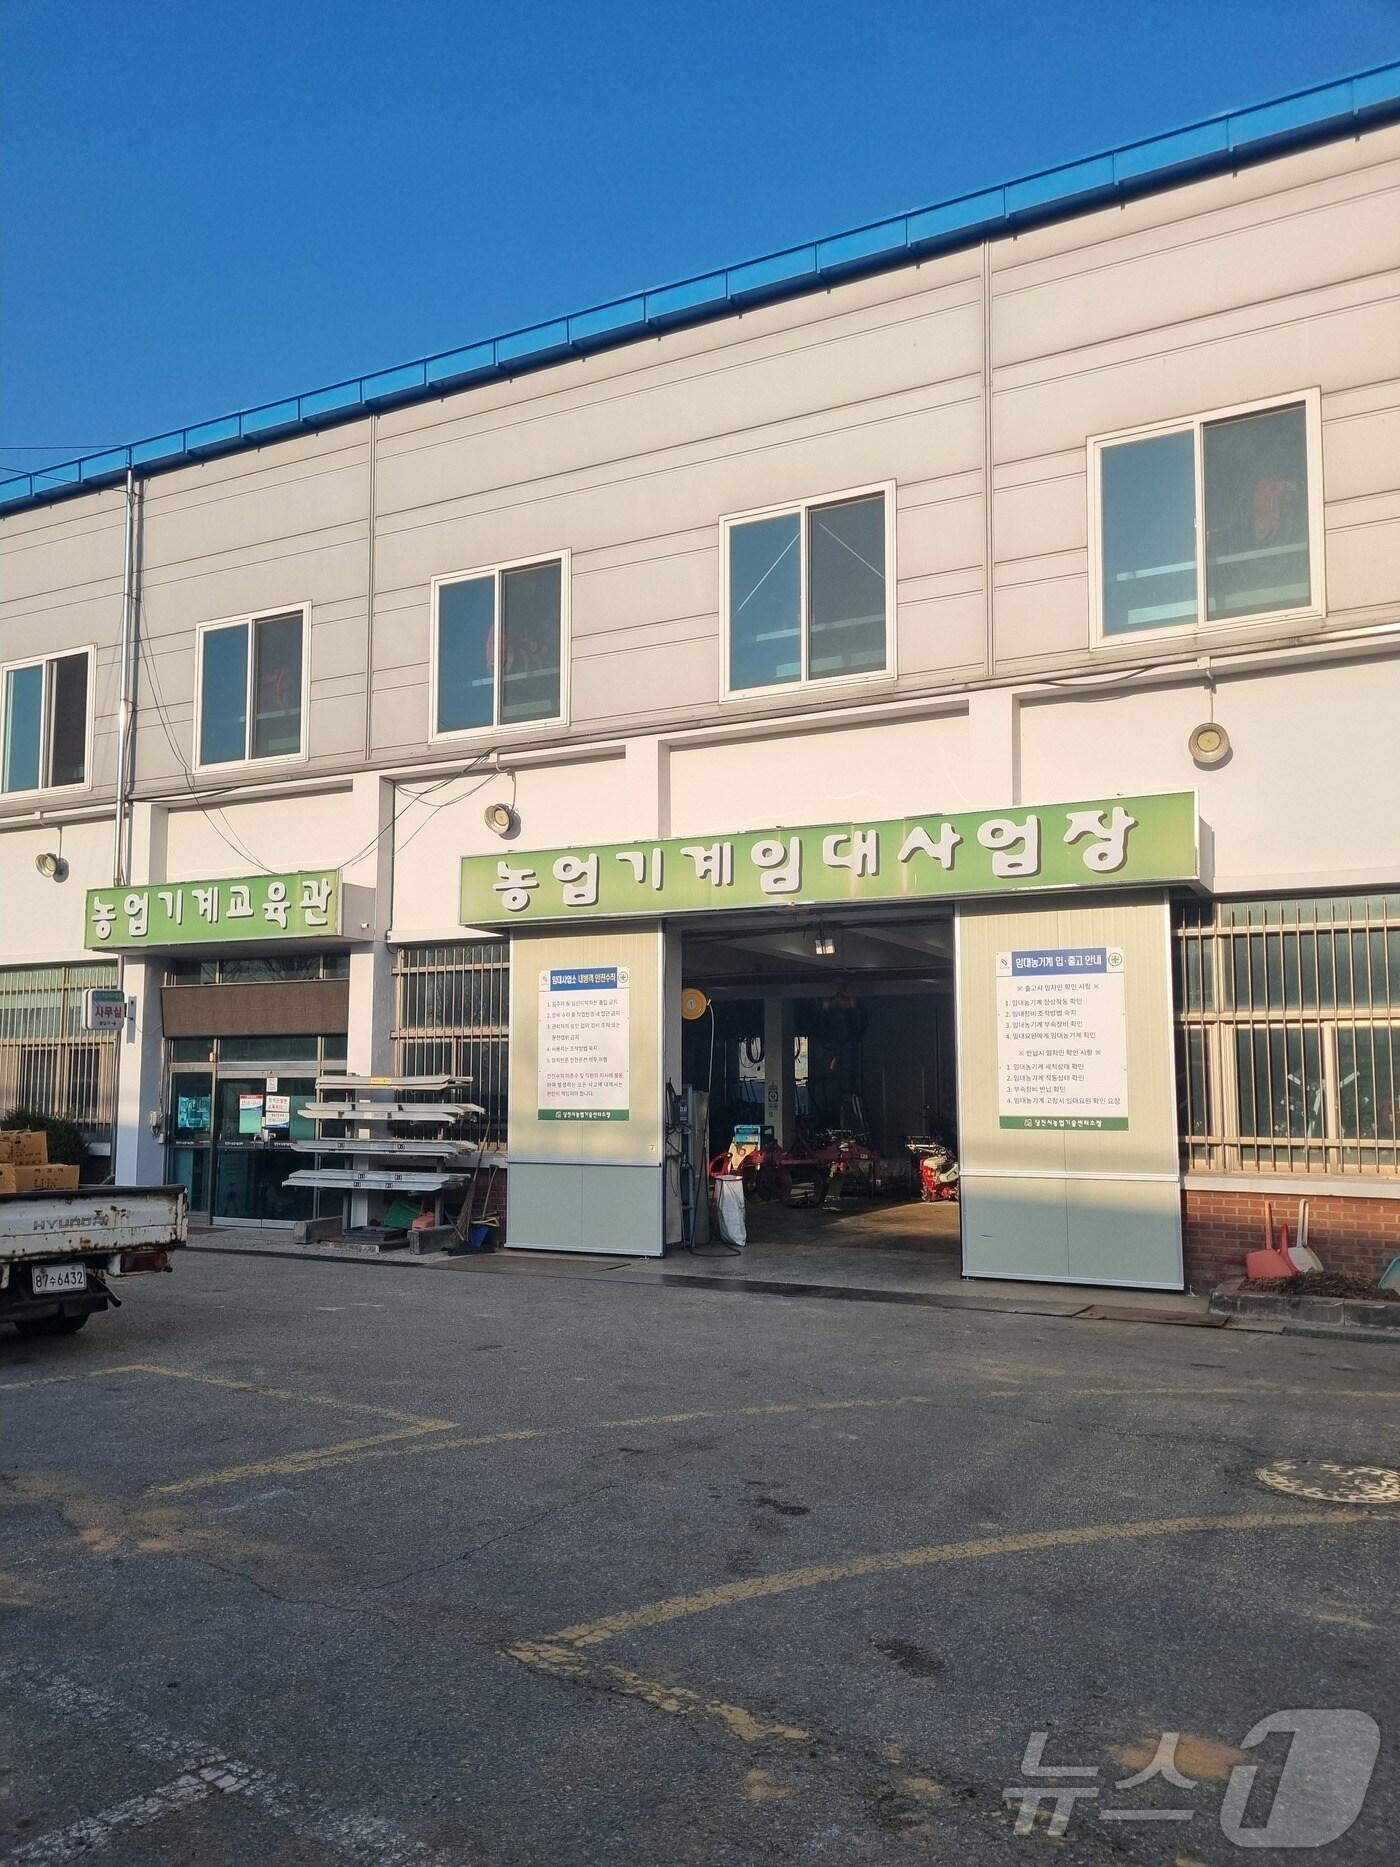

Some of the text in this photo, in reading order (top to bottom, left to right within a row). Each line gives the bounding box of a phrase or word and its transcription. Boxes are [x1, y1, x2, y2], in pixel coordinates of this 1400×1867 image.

[493, 806, 1135, 911] 농업기계임대사업장
[92, 879, 332, 940] 농업기계교육관
[1016, 957, 1053, 968] 임대농기계
[1085, 955, 1101, 965] 안내
[552, 975, 577, 984] 임대사업소
[595, 973, 616, 983] 안전수칙
[95, 1006, 121, 1018] 사무실
[36, 1272, 83, 1287] 87수6432
